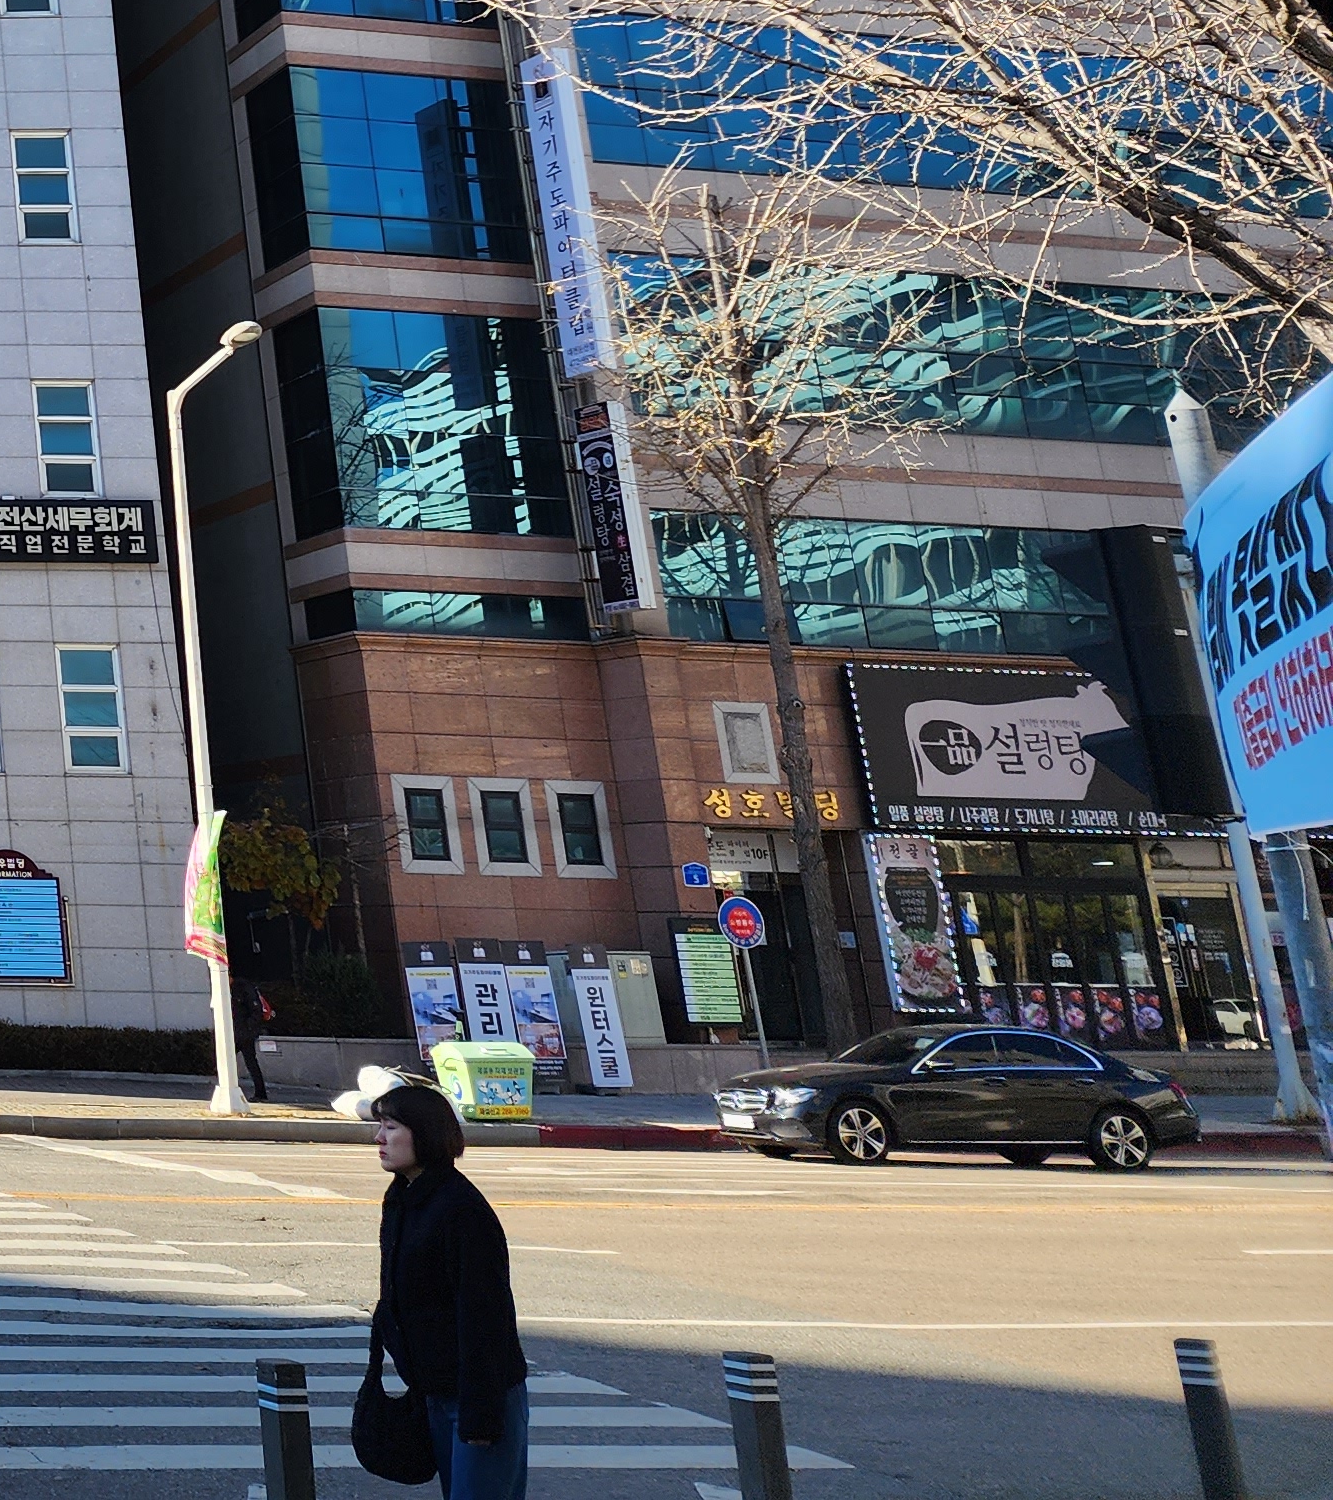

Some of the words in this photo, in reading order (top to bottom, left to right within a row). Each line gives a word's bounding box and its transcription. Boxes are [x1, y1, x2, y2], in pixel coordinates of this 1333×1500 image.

[0, 534, 147, 555] 직업전문학교
[985, 722, 1087, 776] 설렁탕
[475, 984, 514, 1041] 관리
[587, 987, 620, 1078] 윈터스쿨
